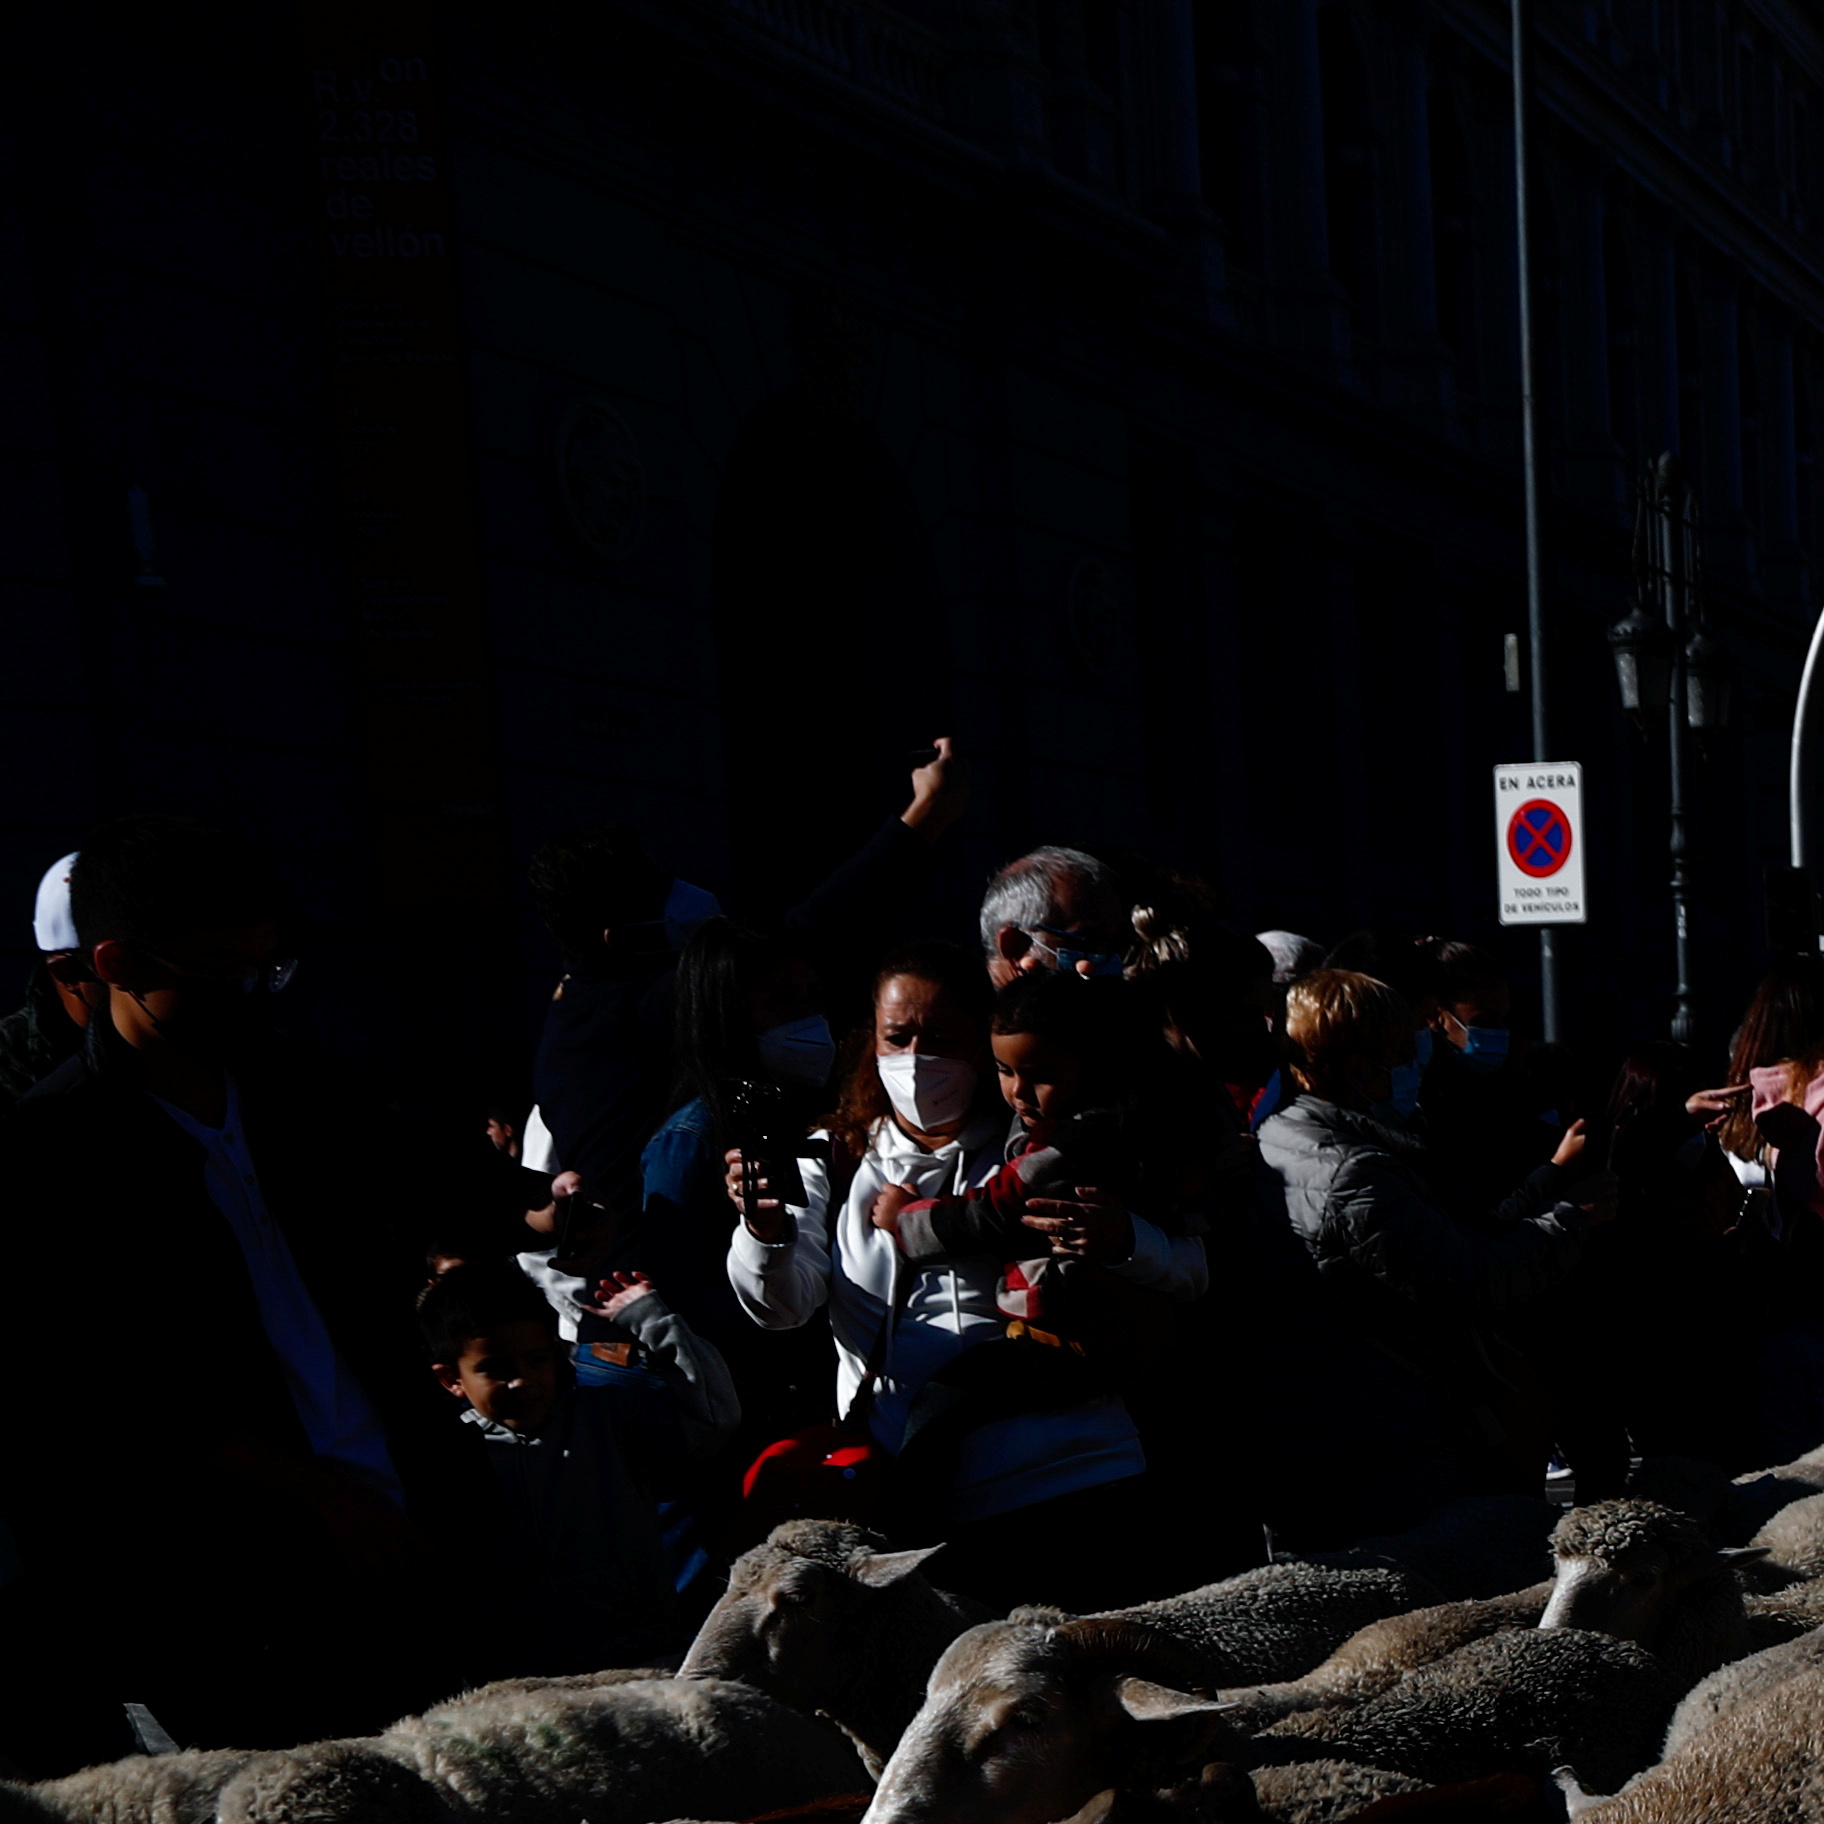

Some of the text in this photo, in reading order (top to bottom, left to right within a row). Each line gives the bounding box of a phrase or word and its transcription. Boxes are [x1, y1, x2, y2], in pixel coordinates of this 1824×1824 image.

[1499, 774, 1576, 790] EN ACERA
[1513, 886, 1569, 898] TODO TIPO
[1504, 903, 1517, 914] DE
